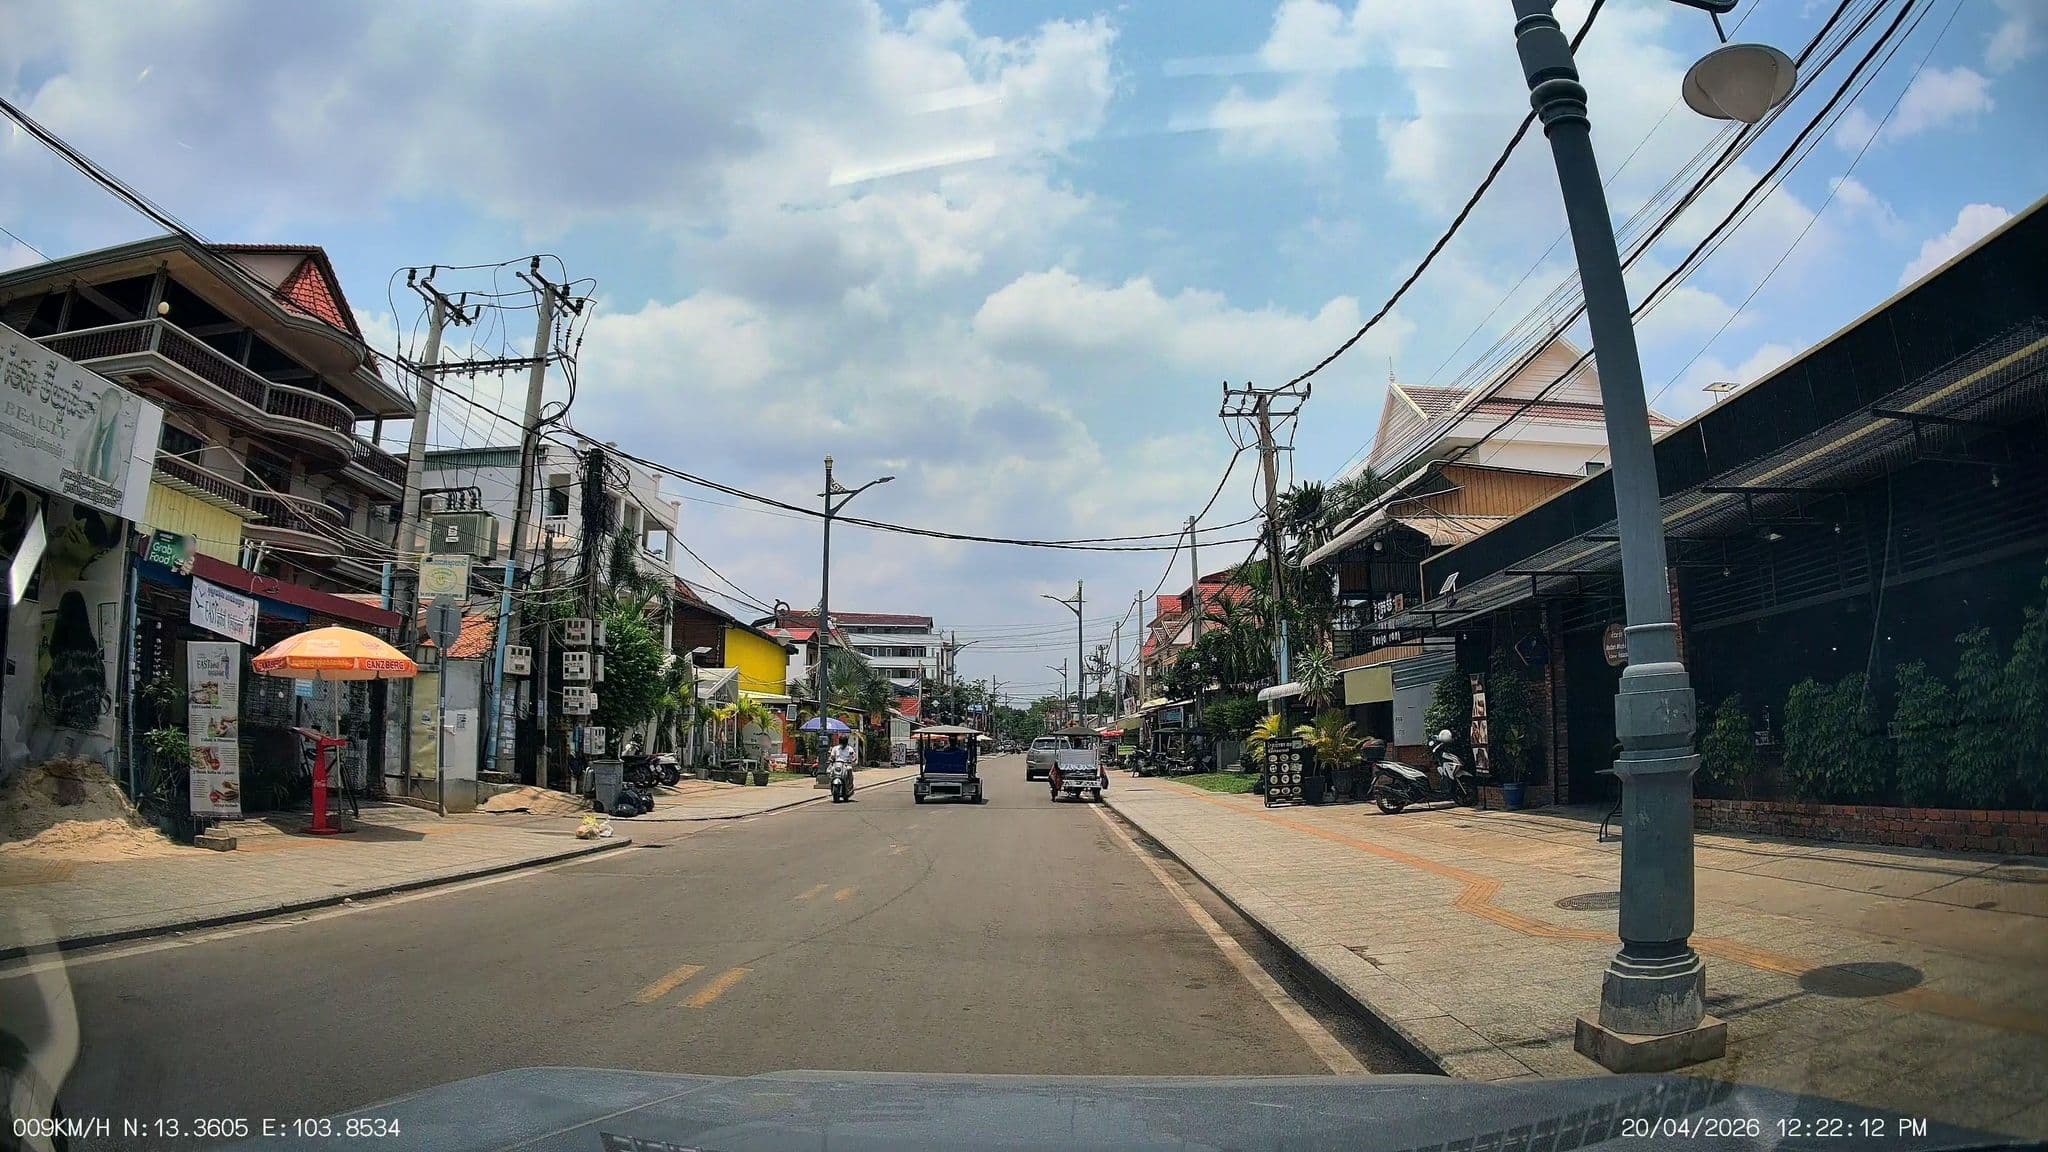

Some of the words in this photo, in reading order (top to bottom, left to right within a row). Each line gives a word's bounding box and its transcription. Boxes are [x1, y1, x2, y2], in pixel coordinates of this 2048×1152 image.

[152, 542, 173, 555] Grab
[149, 551, 171, 565] Food
[366, 660, 404, 670] GANZBERG
